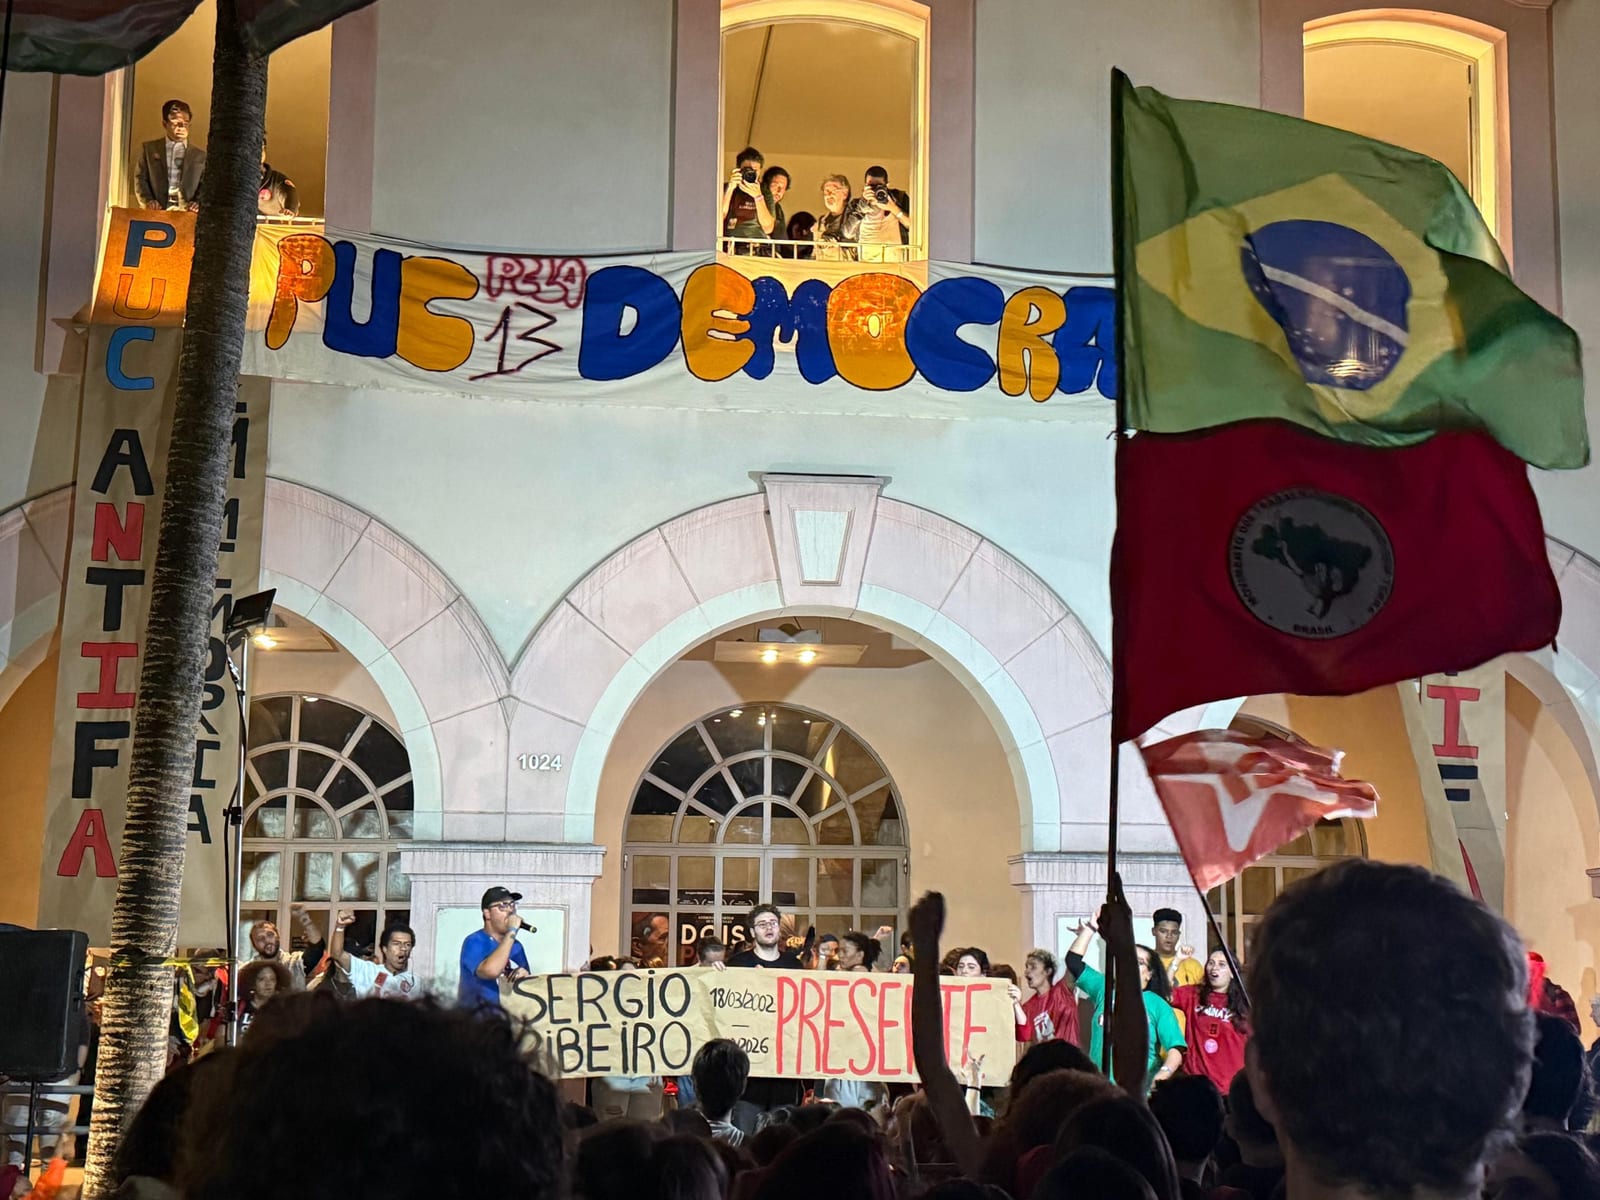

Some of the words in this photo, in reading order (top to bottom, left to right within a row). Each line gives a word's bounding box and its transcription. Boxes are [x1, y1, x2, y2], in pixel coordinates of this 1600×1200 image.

[105, 219, 177, 391] PUC
[56, 428, 155, 878] ANTIFA
[518, 753, 562, 771] 1024
